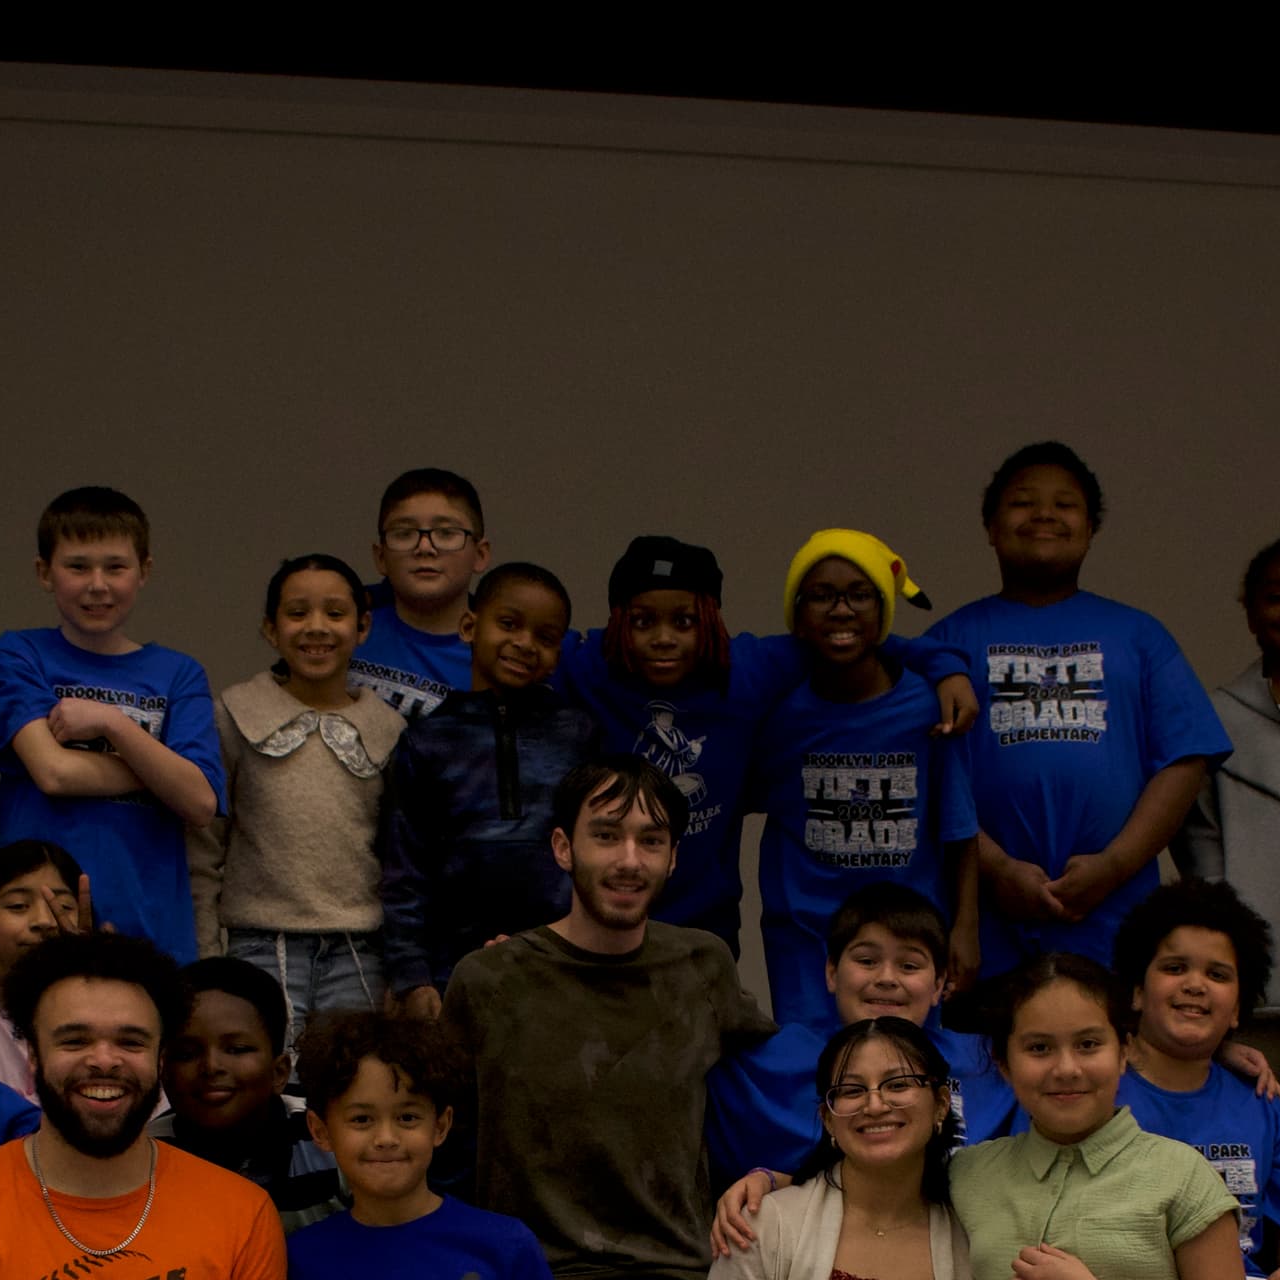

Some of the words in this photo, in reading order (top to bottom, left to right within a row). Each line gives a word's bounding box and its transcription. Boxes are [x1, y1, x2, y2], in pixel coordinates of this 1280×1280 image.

[988, 644, 1059, 656] BROOKLYN
[1062, 641, 1099, 655] PARK
[349, 659, 417, 685] BROOKLYN
[987, 653, 1104, 684] FIFTH
[54, 686, 135, 704] BROOKLYN
[139, 696, 166, 710] PAR
[1029, 687, 1072, 700] 2026
[990, 699, 1107, 733] GRADE
[999, 728, 1100, 746] ELEMENTARY
[803, 754, 873, 766] BROOKLYN
[878, 753, 916, 766] PARK
[838, 804, 884, 819] 2026
[804, 818, 918, 852] GRADE
[1210, 1144, 1251, 1159] PARK
